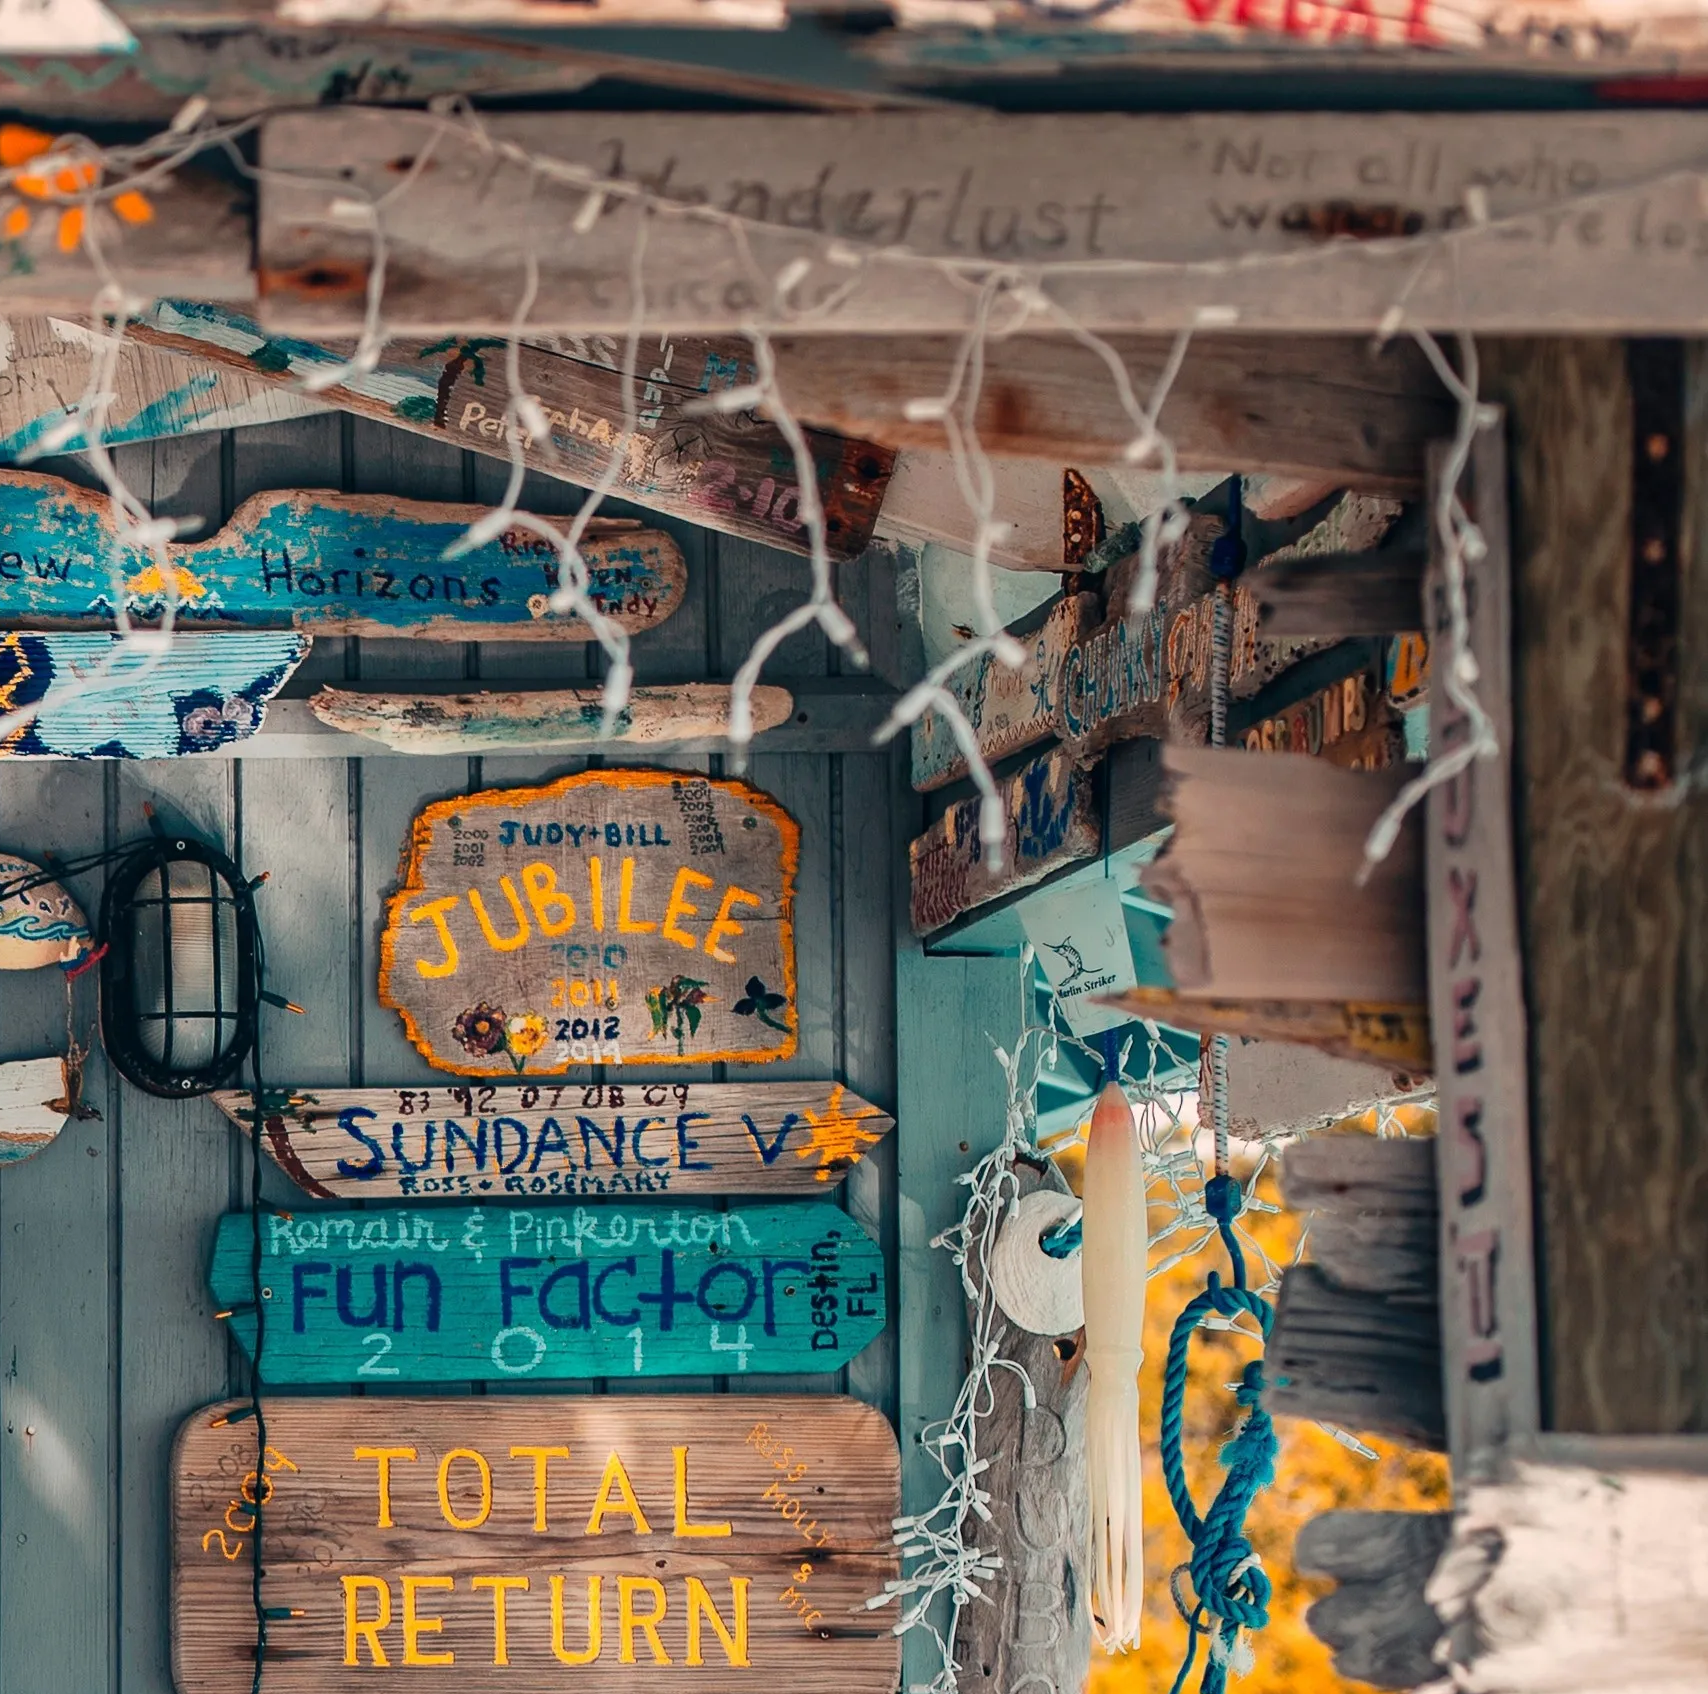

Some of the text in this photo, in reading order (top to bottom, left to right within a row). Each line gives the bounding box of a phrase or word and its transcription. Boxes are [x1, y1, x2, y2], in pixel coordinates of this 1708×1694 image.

[260, 546, 504, 607] Horizons
[409, 855, 762, 980] JUBILEE
[1084, 973, 1118, 993] Striker
[553, 1016, 622, 1043] 2012
[336, 1106, 714, 1181] SUNDANCE
[502, 1171, 673, 1197] ROSEMARY
[506, 1205, 761, 1253] Pinkerton
[846, 1271, 879, 1318] FL
[353, 1445, 734, 1539] TOTAL
[339, 1574, 754, 1668] RETURN
